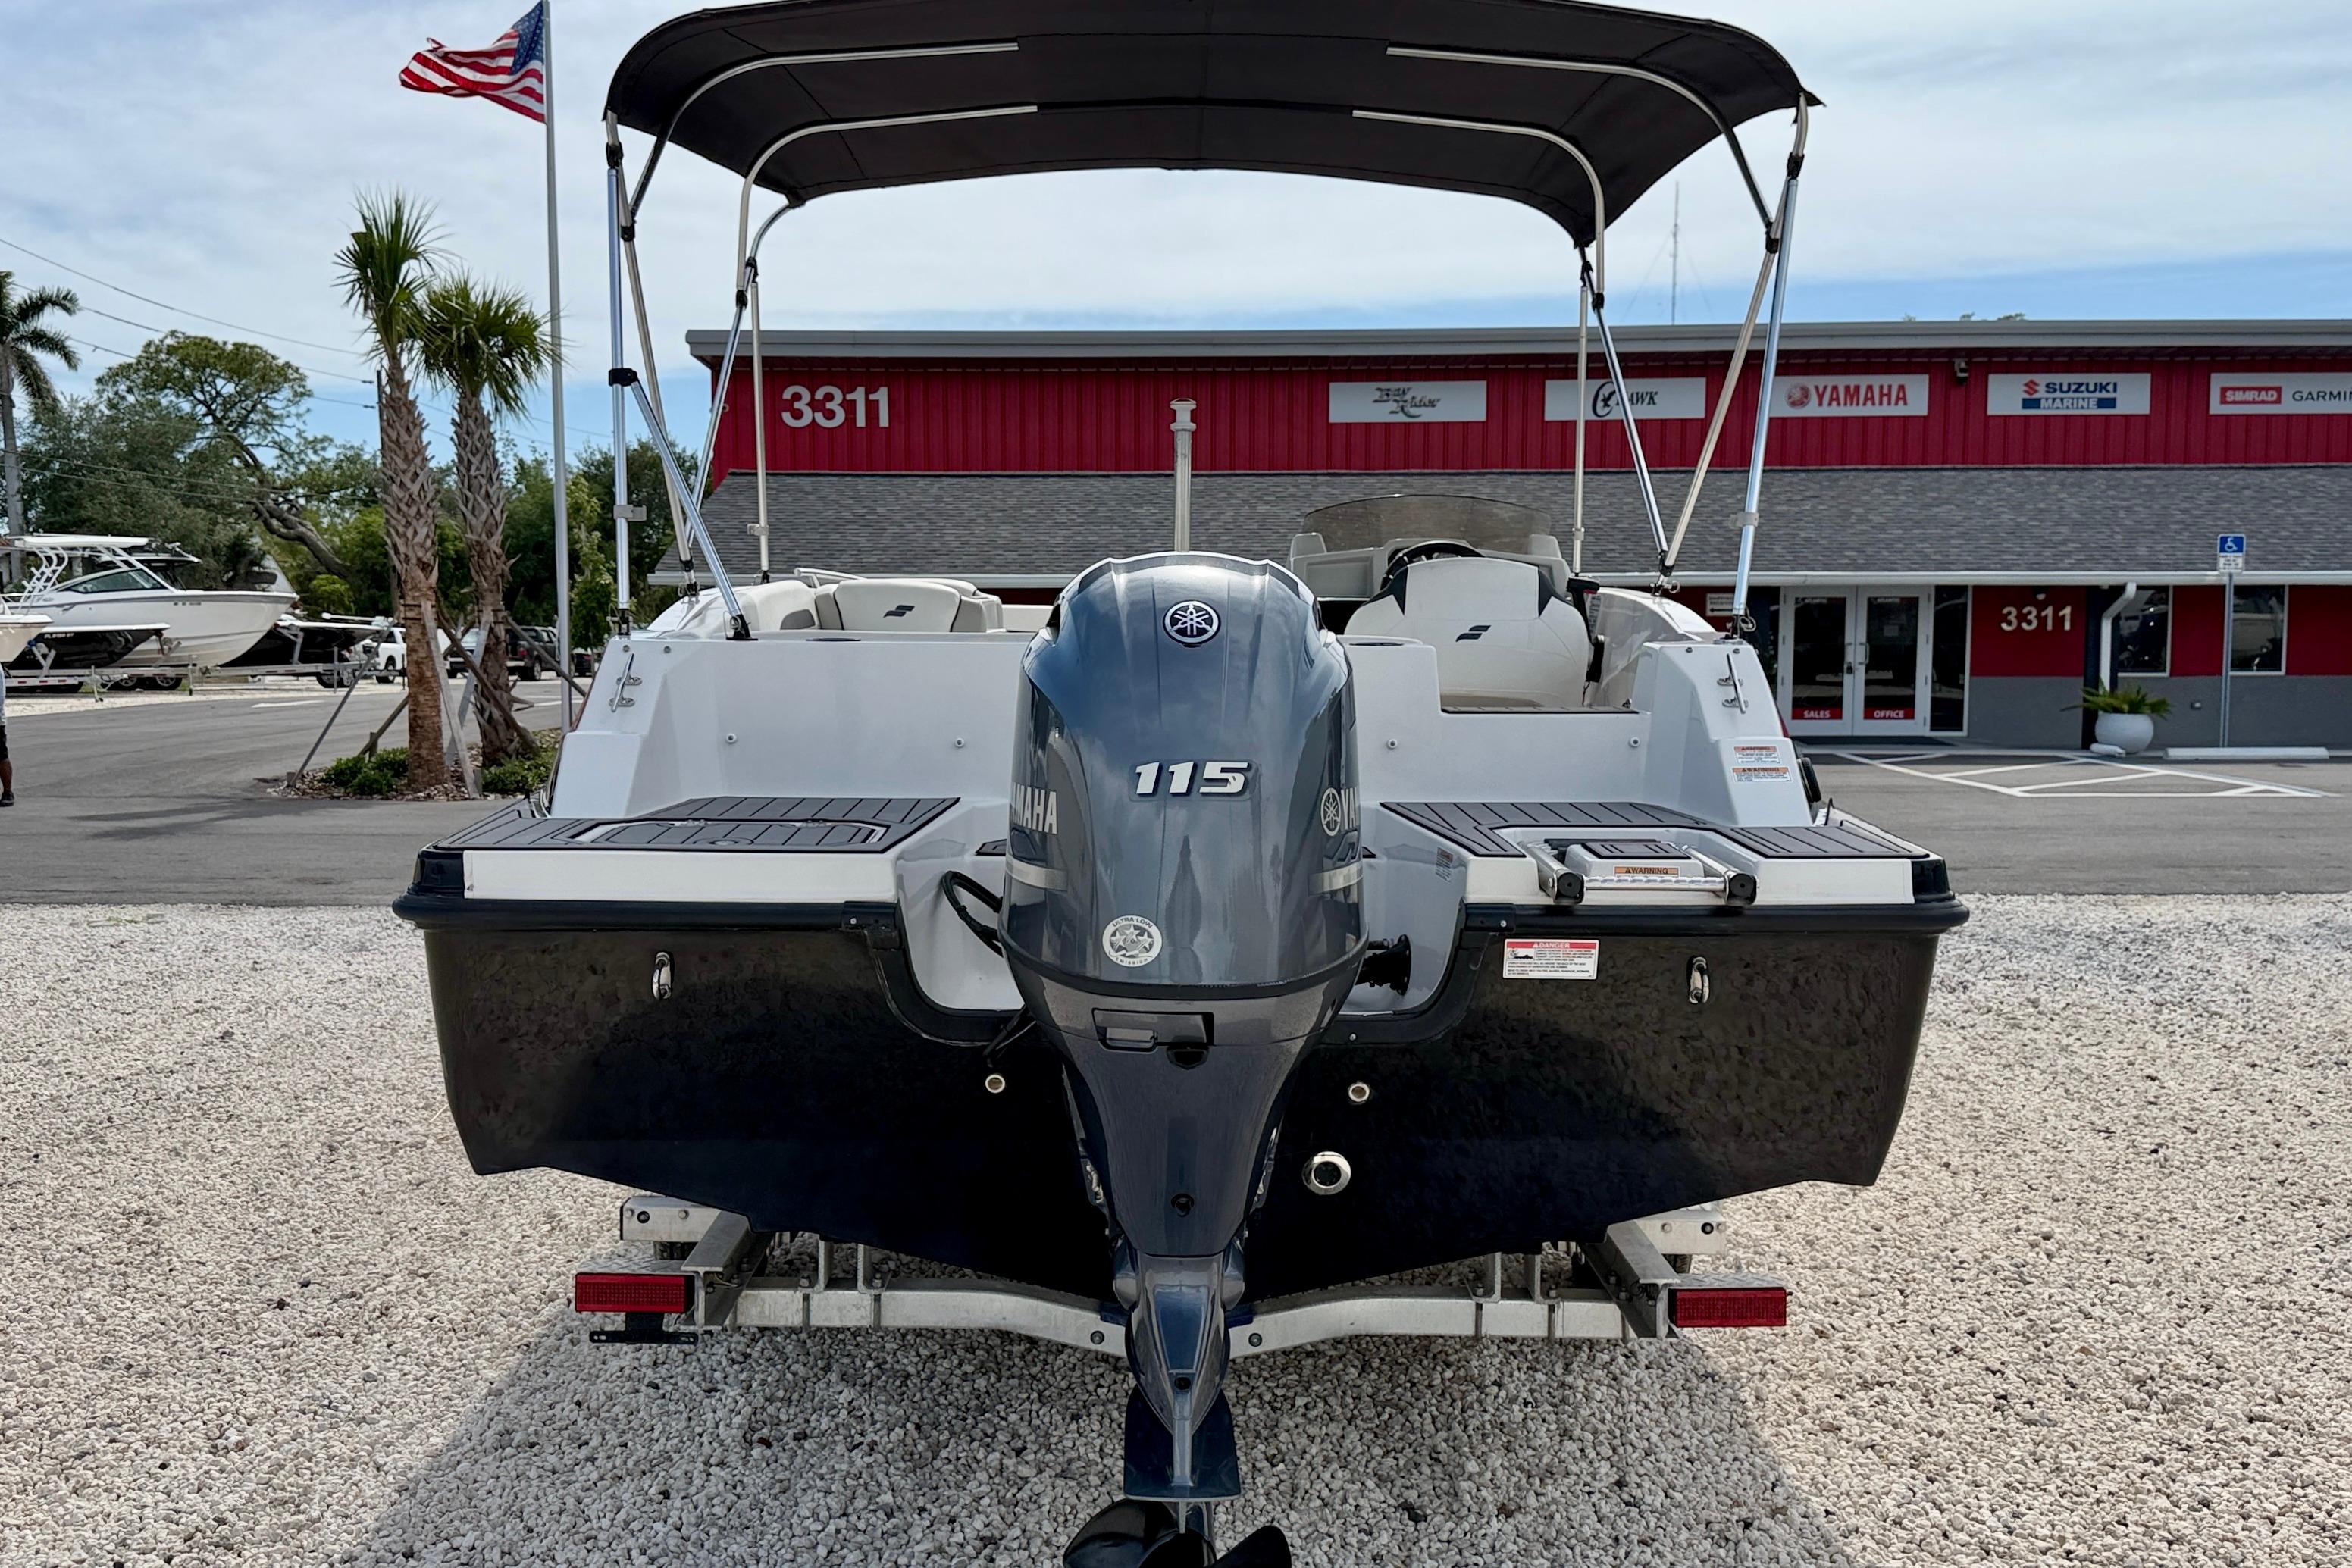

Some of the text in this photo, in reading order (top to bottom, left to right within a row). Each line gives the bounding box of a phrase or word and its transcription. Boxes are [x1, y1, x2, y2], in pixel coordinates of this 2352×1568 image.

[2044, 381, 2118, 393] SUZUKI
[1615, 391, 1659, 406] AWK
[1814, 383, 1909, 408] YAMAHA
[2225, 390, 2278, 402] SIMRAD
[781, 384, 889, 428] 3311
[2040, 397, 2098, 409] MARINE
[2000, 606, 2072, 631] 3311
[1803, 709, 1831, 718] SALES
[1873, 709, 1905, 718] OFFICE
[1135, 761, 1251, 797] 115
